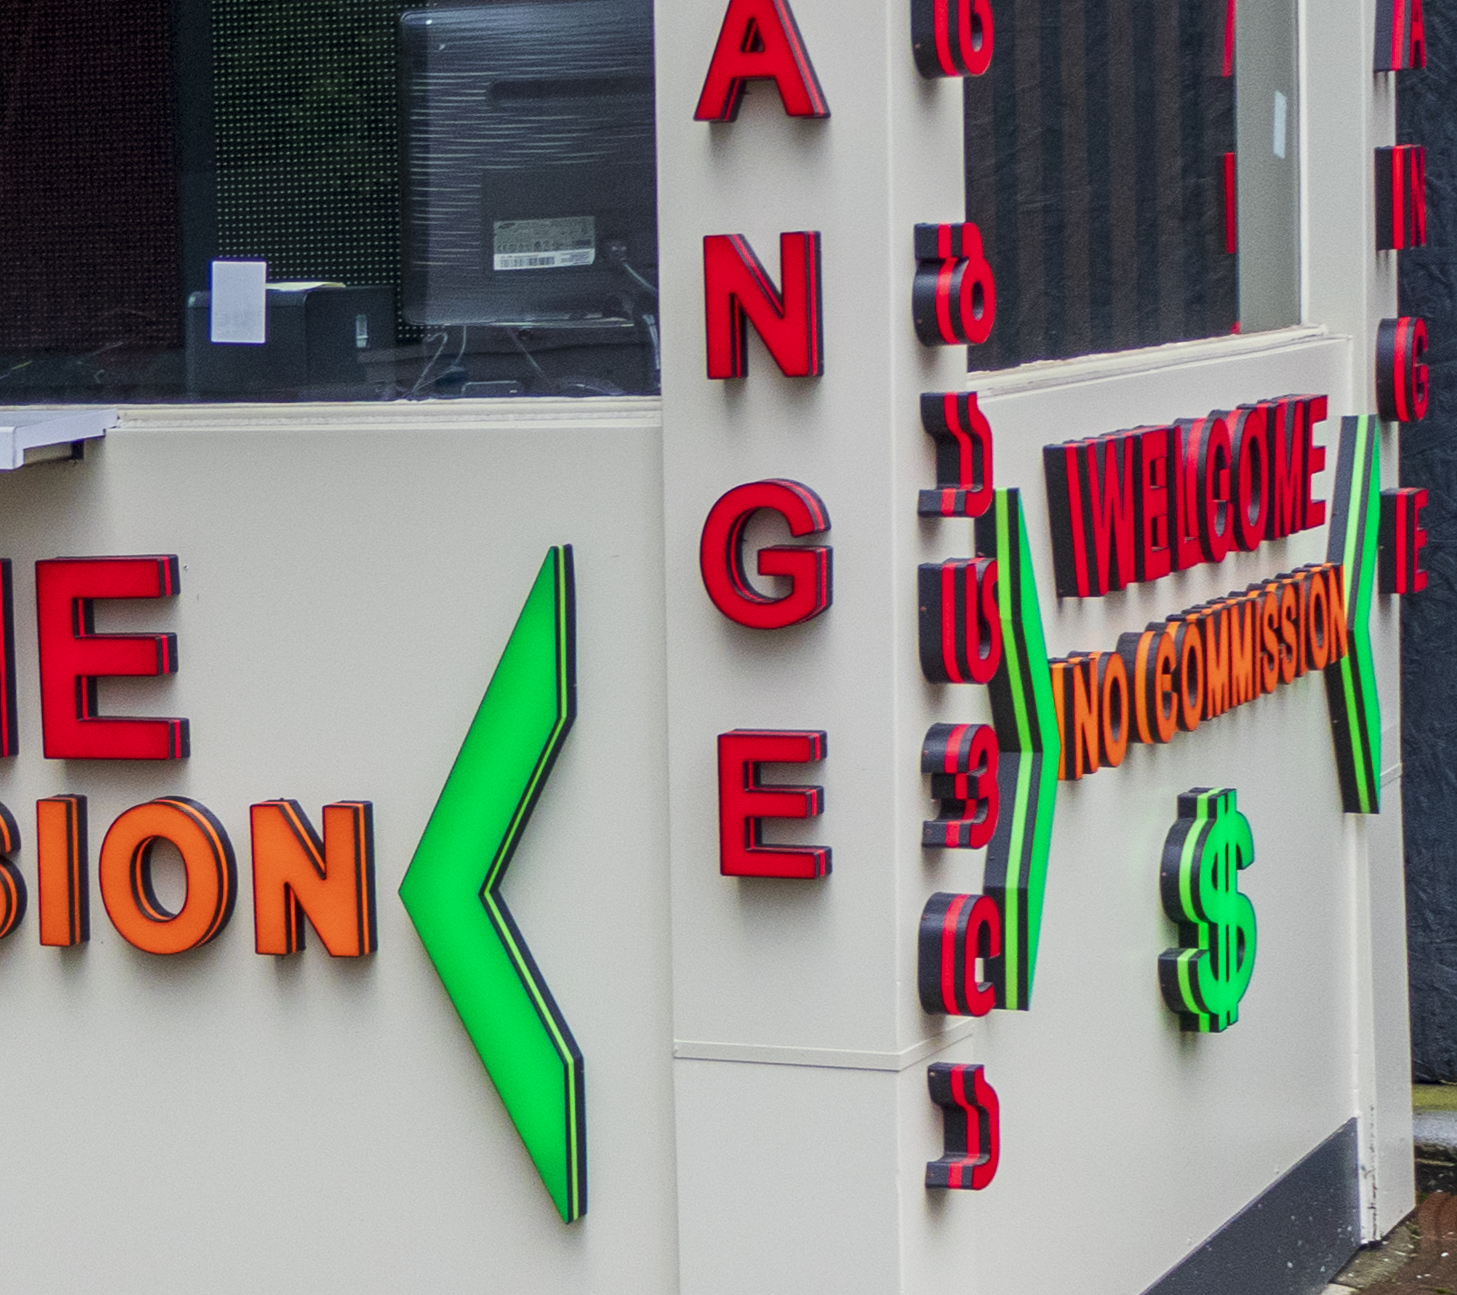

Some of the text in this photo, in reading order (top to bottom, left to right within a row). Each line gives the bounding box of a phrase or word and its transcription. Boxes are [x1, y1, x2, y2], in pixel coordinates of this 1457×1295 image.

[1043, 394, 1329, 598] WELCOME
[1049, 562, 1348, 780] NO COMMISSION
[1159, 787, 1257, 1033] $
